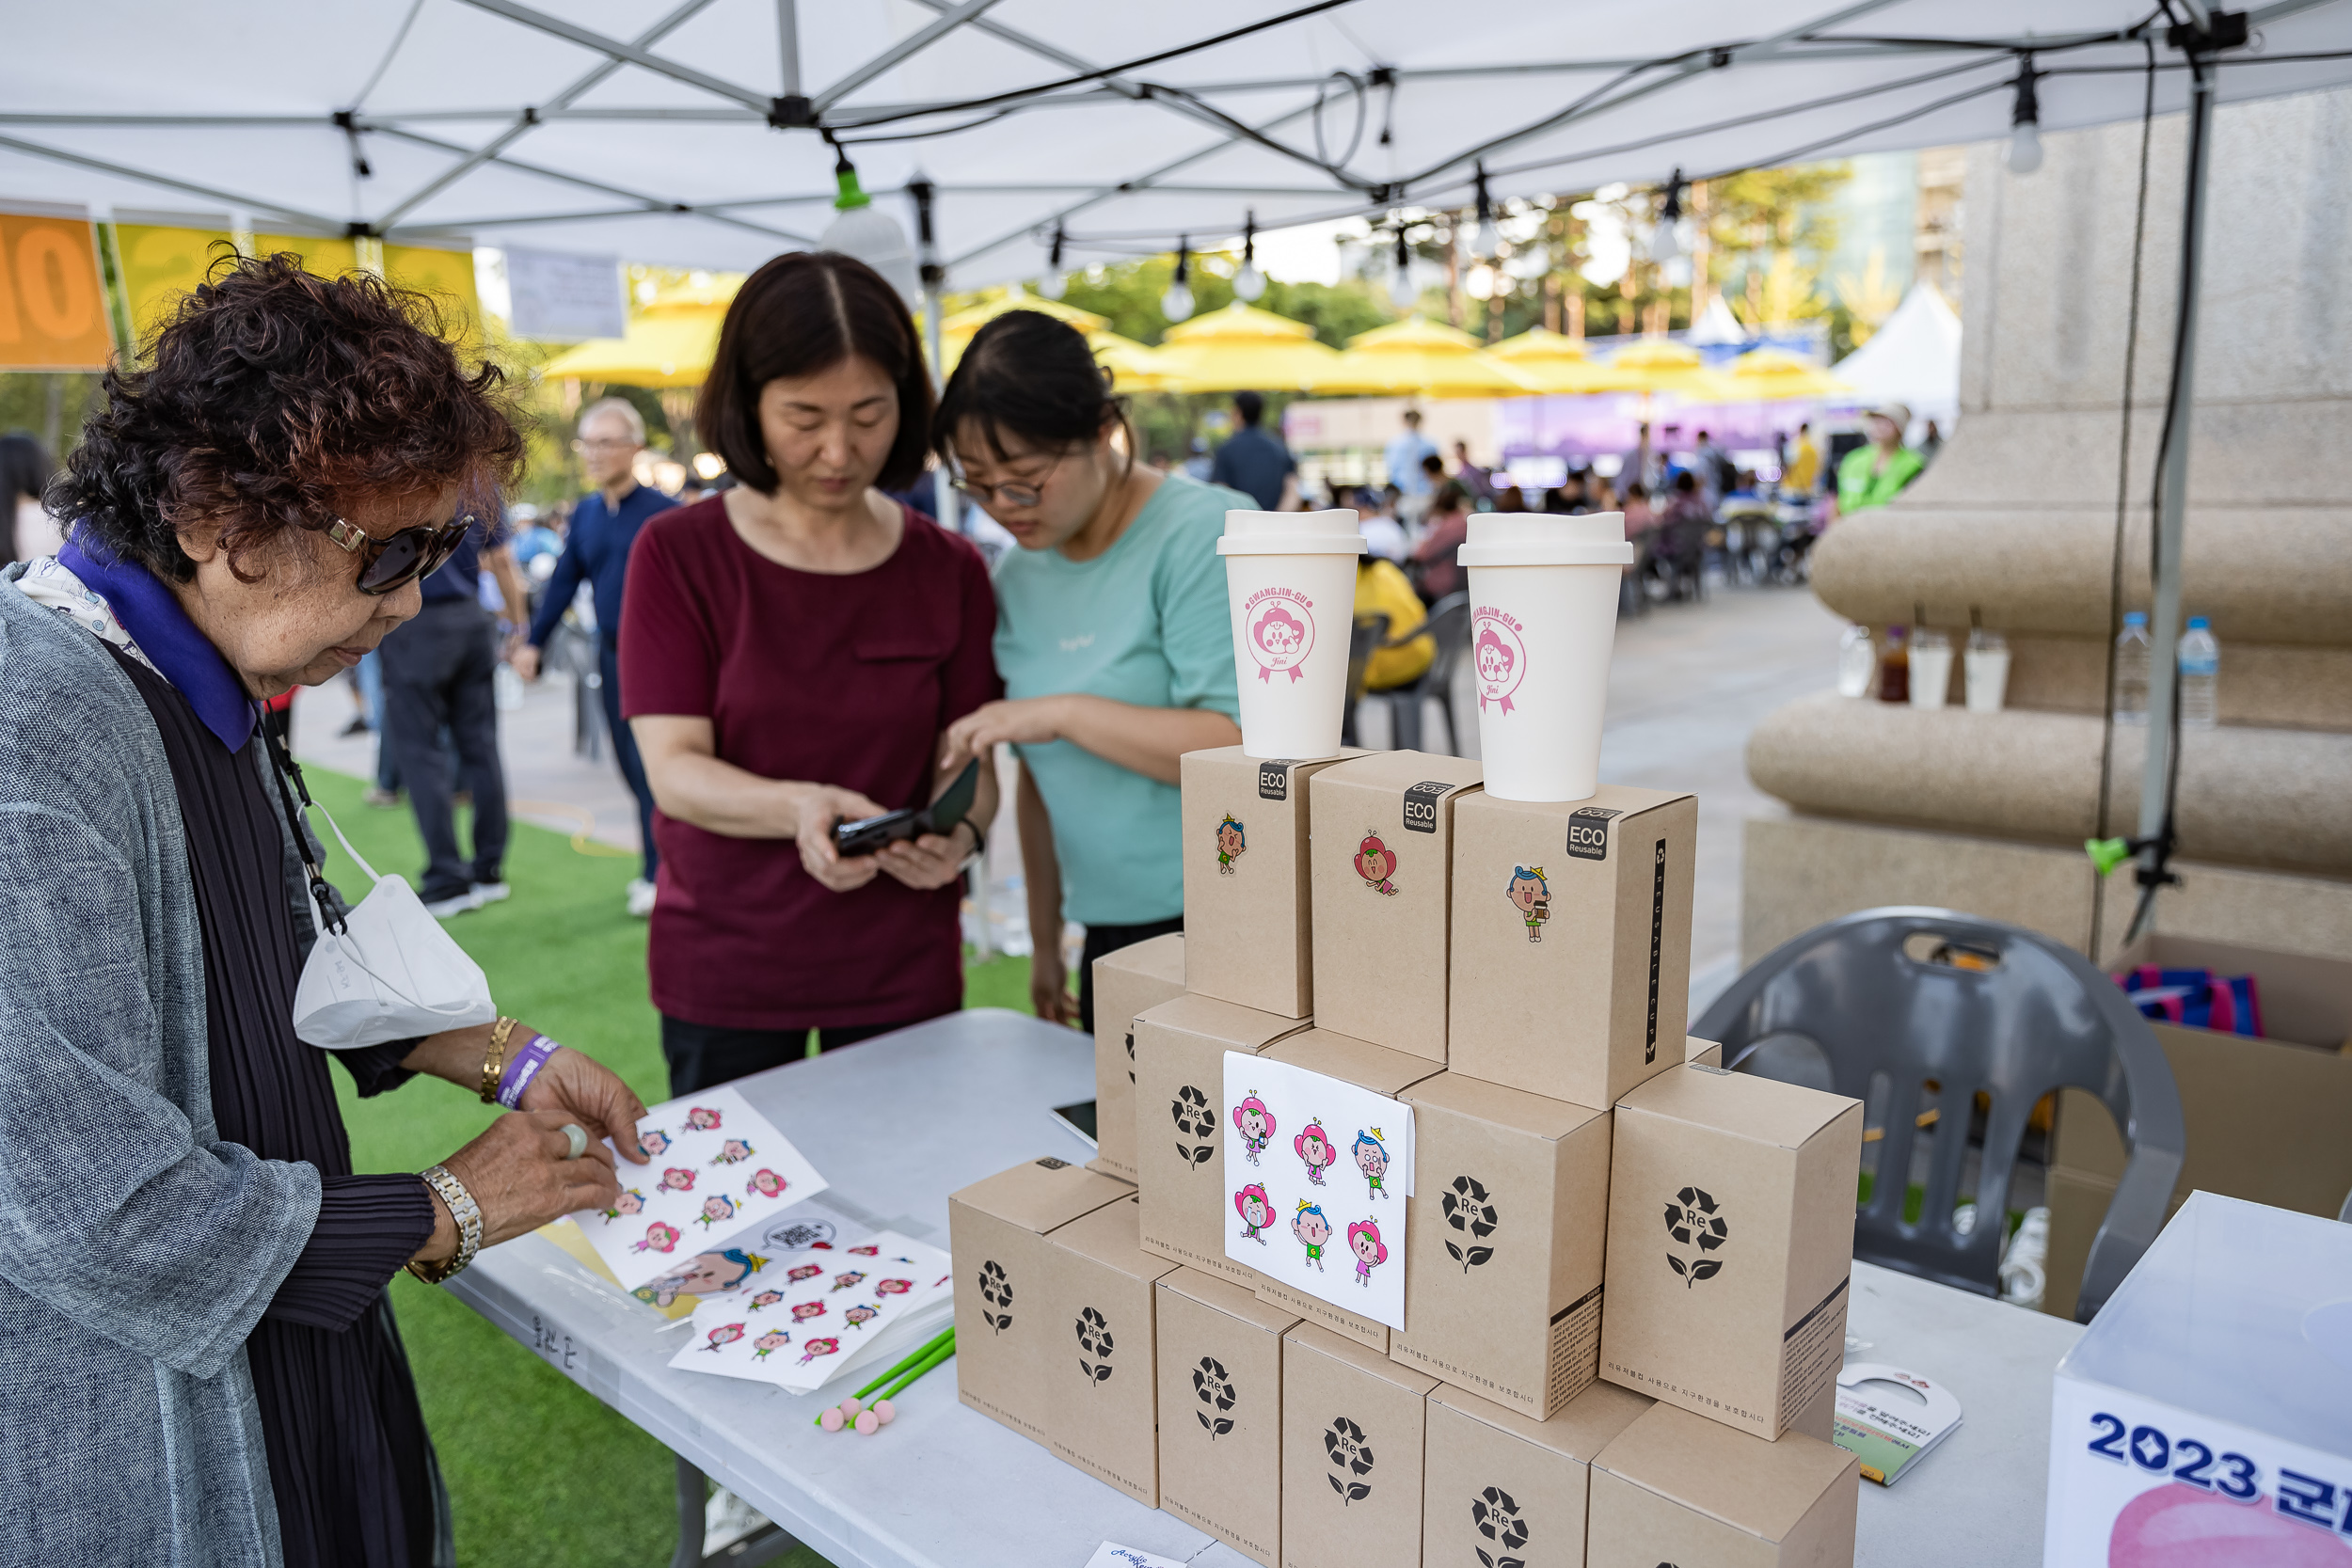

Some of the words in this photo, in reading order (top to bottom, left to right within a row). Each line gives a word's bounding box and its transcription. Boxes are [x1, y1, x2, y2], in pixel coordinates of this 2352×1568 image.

[1248, 587, 1308, 605] GWANGJIN-GU
[1270, 657, 1288, 667] Jini
[1261, 772, 1285, 788] ECO
[1261, 787, 1284, 796] Reusable
[1406, 801, 1435, 820] ECO
[1406, 817, 1434, 829] Reusable
[1570, 826, 1605, 846] ECO
[1570, 843, 1603, 855] Reusable
[1652, 876, 1662, 985] REUSABLE
[1186, 1105, 1200, 1120] Re
[1461, 1197, 1478, 1216] Re
[1687, 1210, 1706, 1228] Re
[1145, 1235, 1170, 1250] 리유저블컵
[1172, 1246, 1193, 1259] 사용으로
[1195, 1254, 1222, 1269] 지구환경을
[1225, 1265, 1253, 1280] 보호합시다
[991, 1277, 1001, 1291] Re
[1261, 1283, 1288, 1300] 리유저블컵
[1291, 1296, 1312, 1311] 사용으로
[1315, 1307, 1345, 1325] 지구환경을
[1348, 1321, 1379, 1338] 보호합시다
[1089, 1324, 1100, 1340] Re
[1396, 1342, 1428, 1362] 리유저블컵
[1432, 1357, 1457, 1374] 사용으로
[1461, 1370, 1495, 1389] 지구환경을
[1499, 1385, 1534, 1404] 보호합시다
[1207, 1375, 1221, 1391] Re
[1608, 1362, 1644, 1381] 리유저블컵
[1648, 1376, 1677, 1392] 사용으로
[1681, 1389, 1720, 1408] 지구환경을
[1724, 1403, 1764, 1423] 보호합시다
[1341, 1437, 1357, 1454] Re
[2087, 1412, 2257, 1499] 2023
[2277, 1466, 2352, 1535] 군
[1492, 1508, 1509, 1528] Re
[1111, 1549, 1148, 1563] Acrylic
